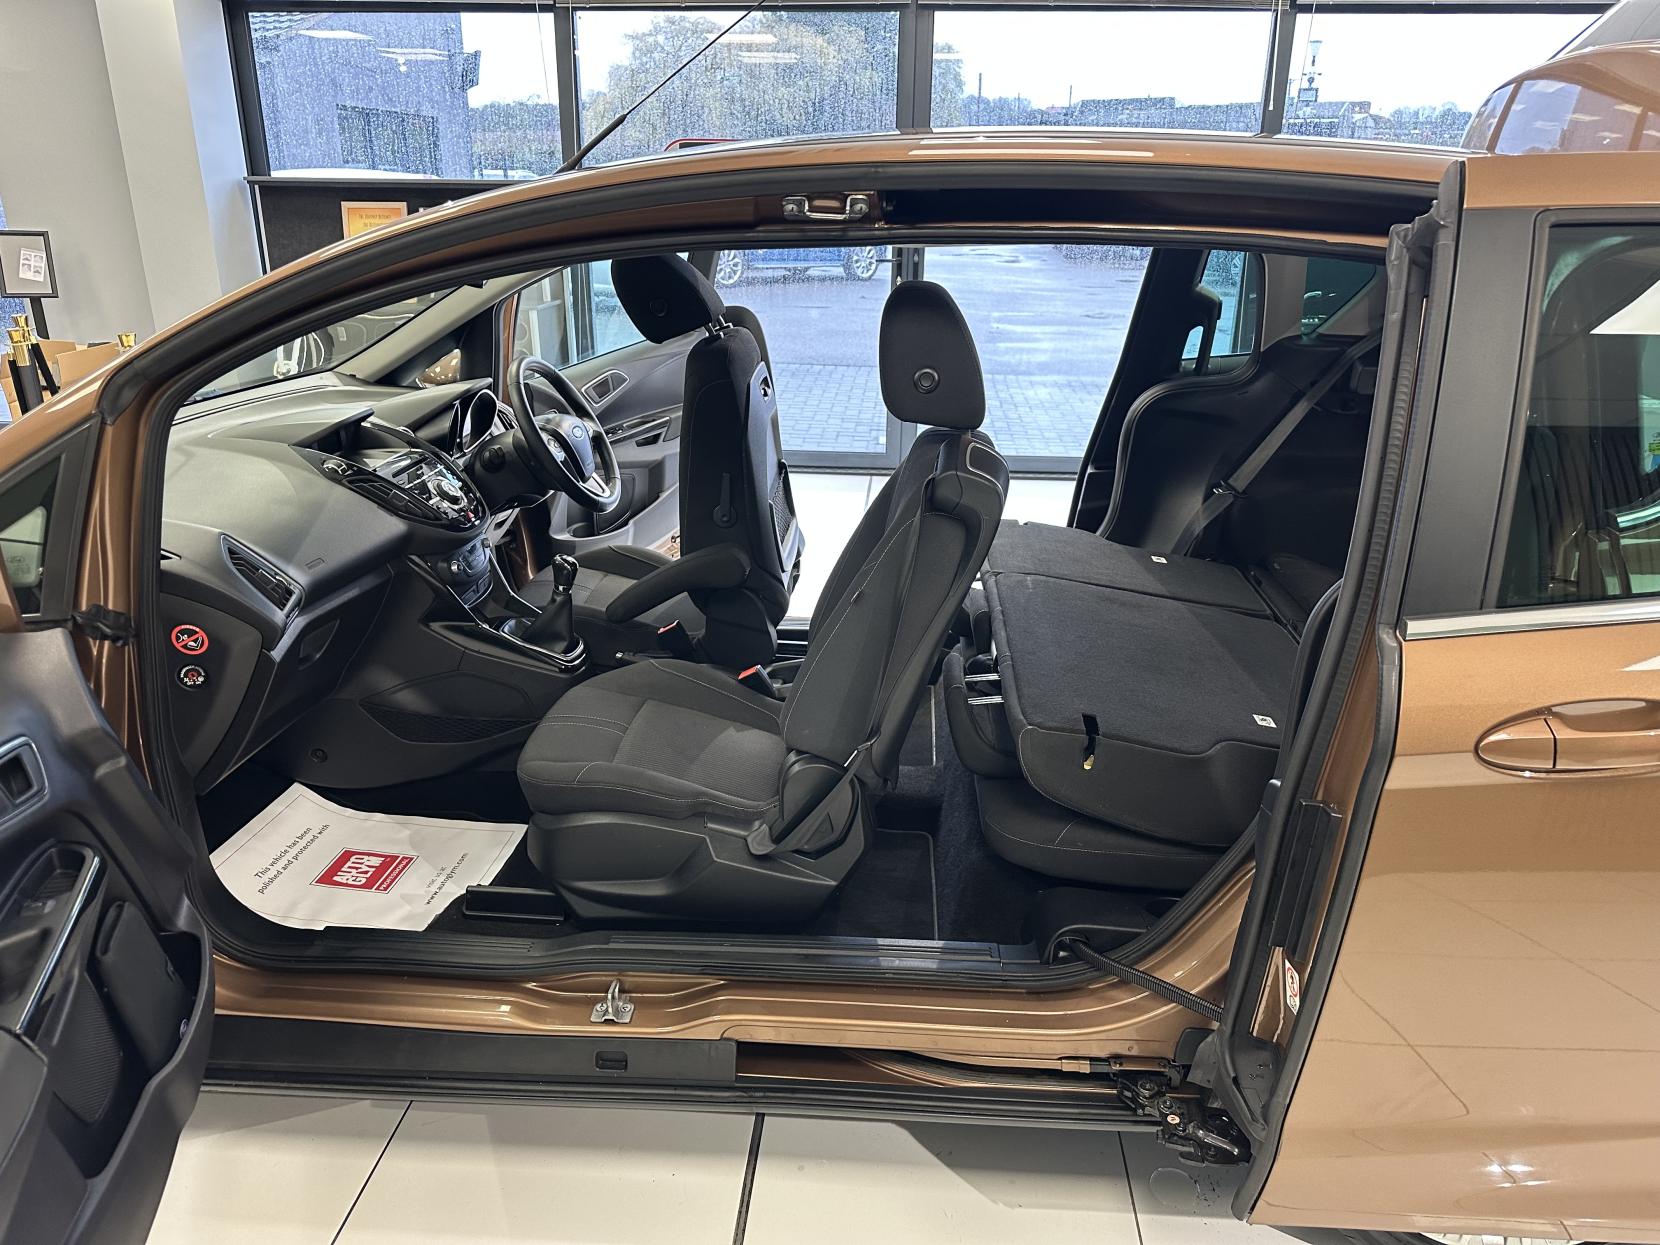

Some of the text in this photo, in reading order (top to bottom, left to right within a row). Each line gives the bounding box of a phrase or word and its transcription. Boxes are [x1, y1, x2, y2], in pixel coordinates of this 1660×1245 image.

[254, 827, 312, 879] This vehicle has been
[257, 824, 331, 895] polished and protected with
[332, 854, 369, 883] AUTO
[344, 856, 386, 886] GLYM
